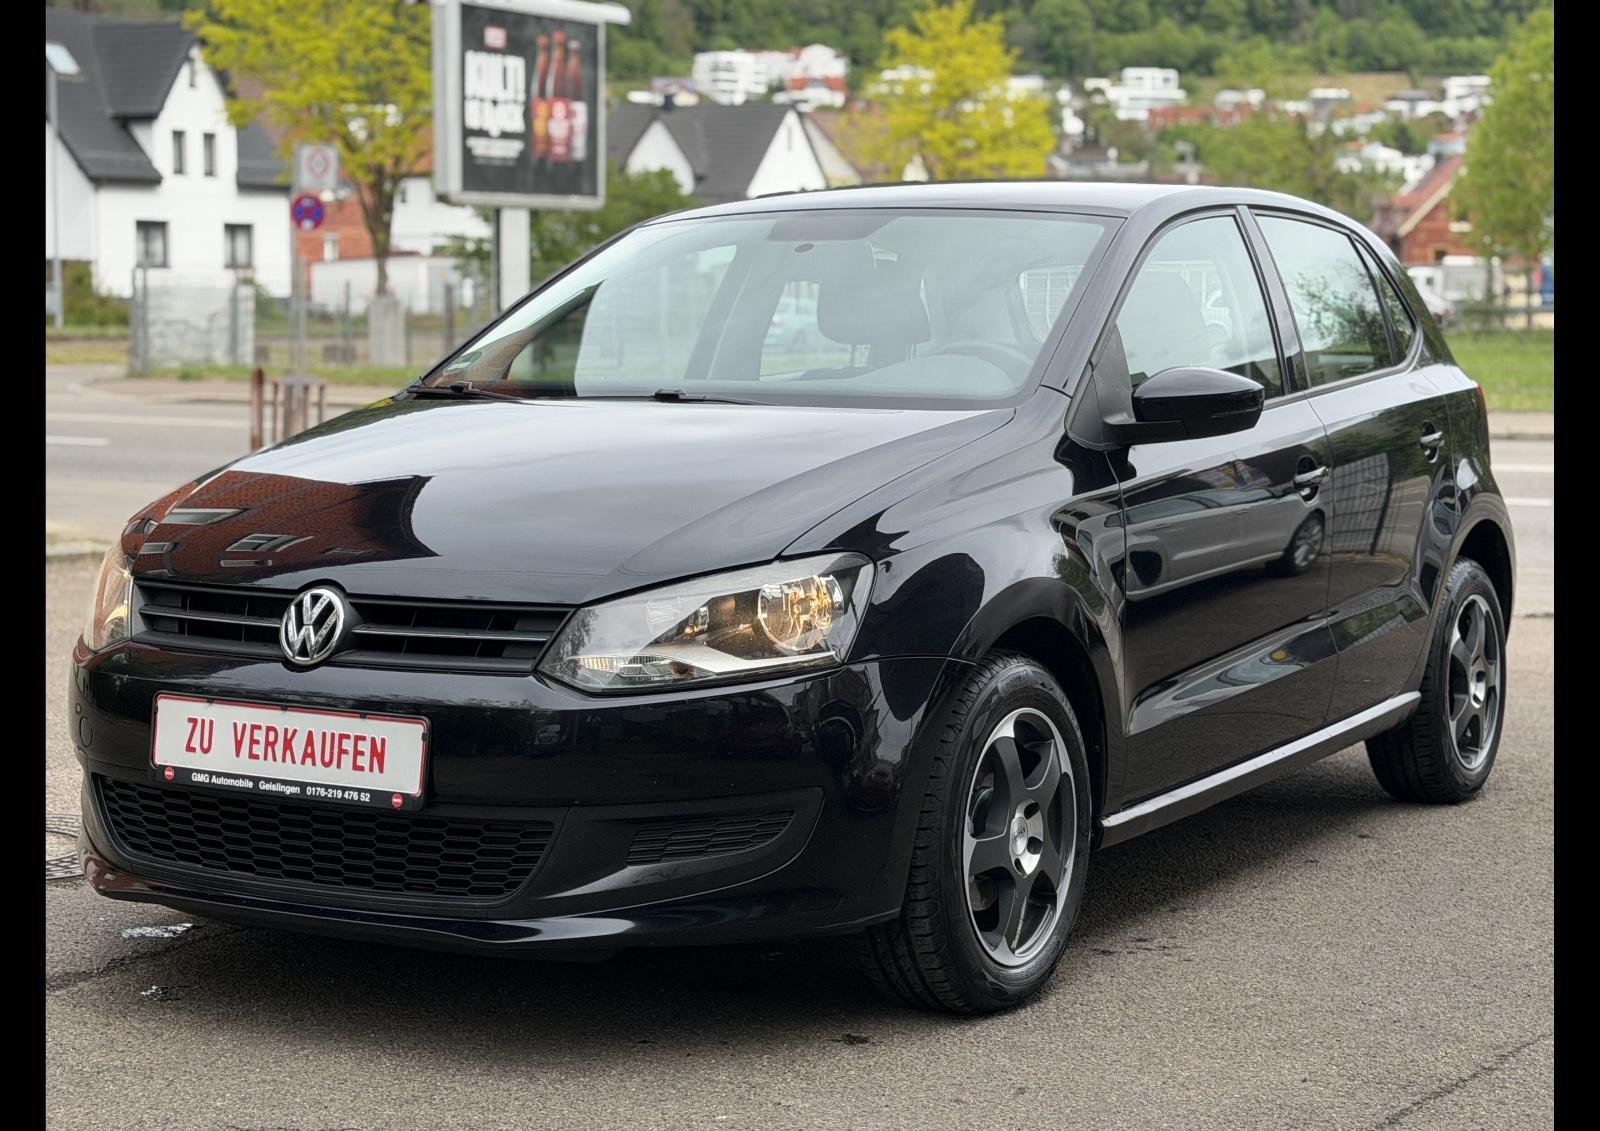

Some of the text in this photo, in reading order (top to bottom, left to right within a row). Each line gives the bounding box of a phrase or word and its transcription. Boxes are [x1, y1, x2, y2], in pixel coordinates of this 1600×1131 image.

[185, 717, 386, 774] ZU VERKAUFEN
[191, 772, 371, 802] GMG Automobile Geislingen 0176-219 476 52
